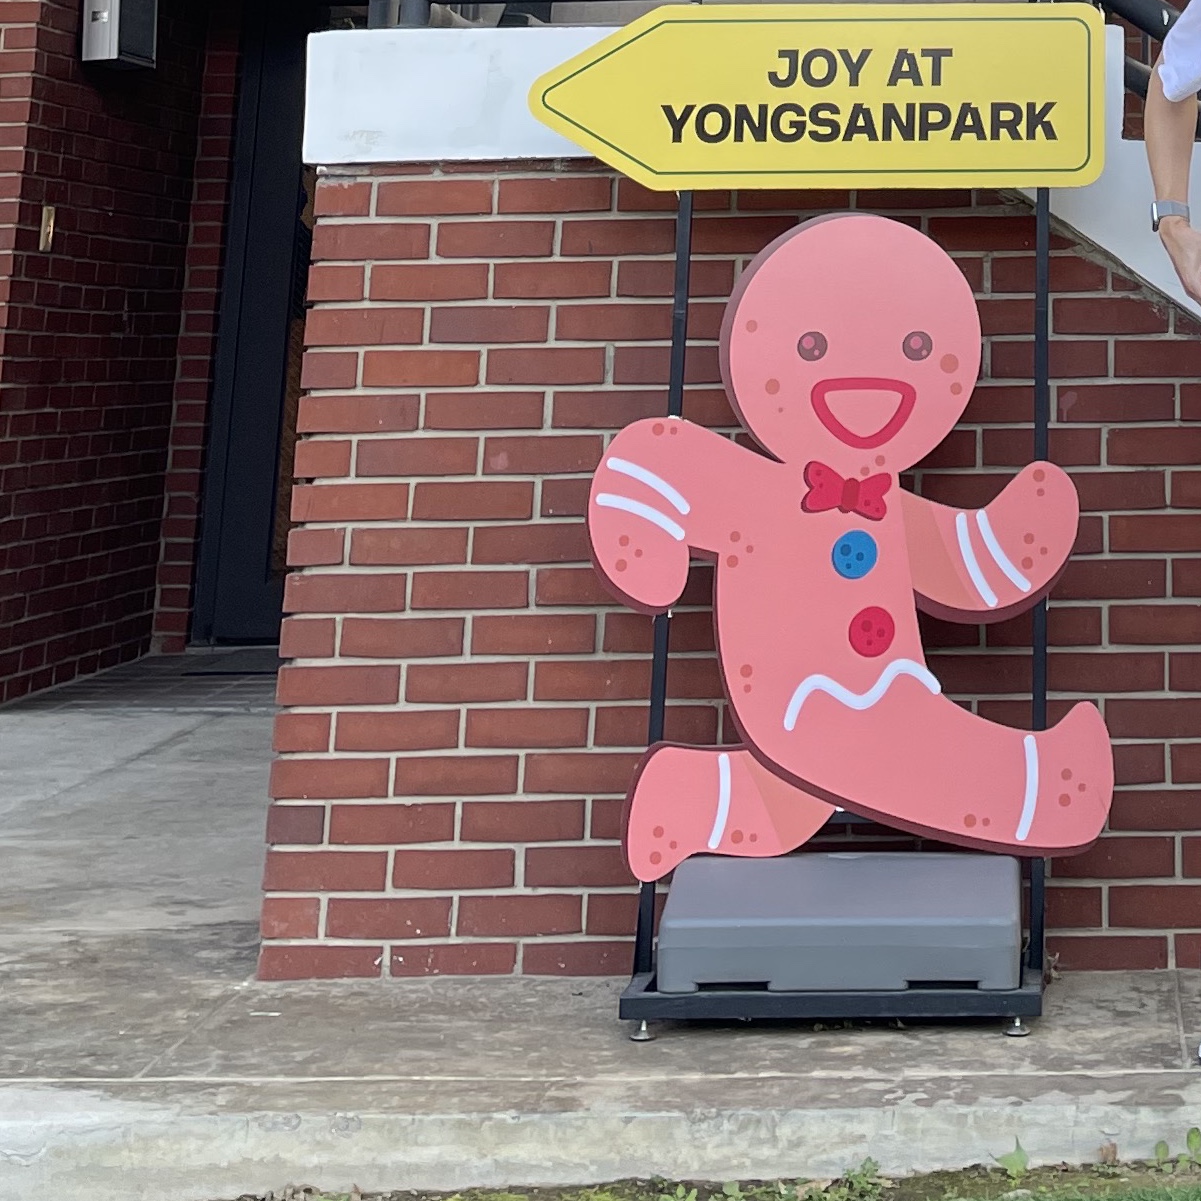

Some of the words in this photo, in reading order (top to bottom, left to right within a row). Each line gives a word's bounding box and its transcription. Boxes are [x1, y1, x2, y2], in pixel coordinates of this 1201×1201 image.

[767, 48, 873, 89] JOY
[886, 48, 954, 87] AT
[661, 102, 1059, 144] YONGSANPARK
